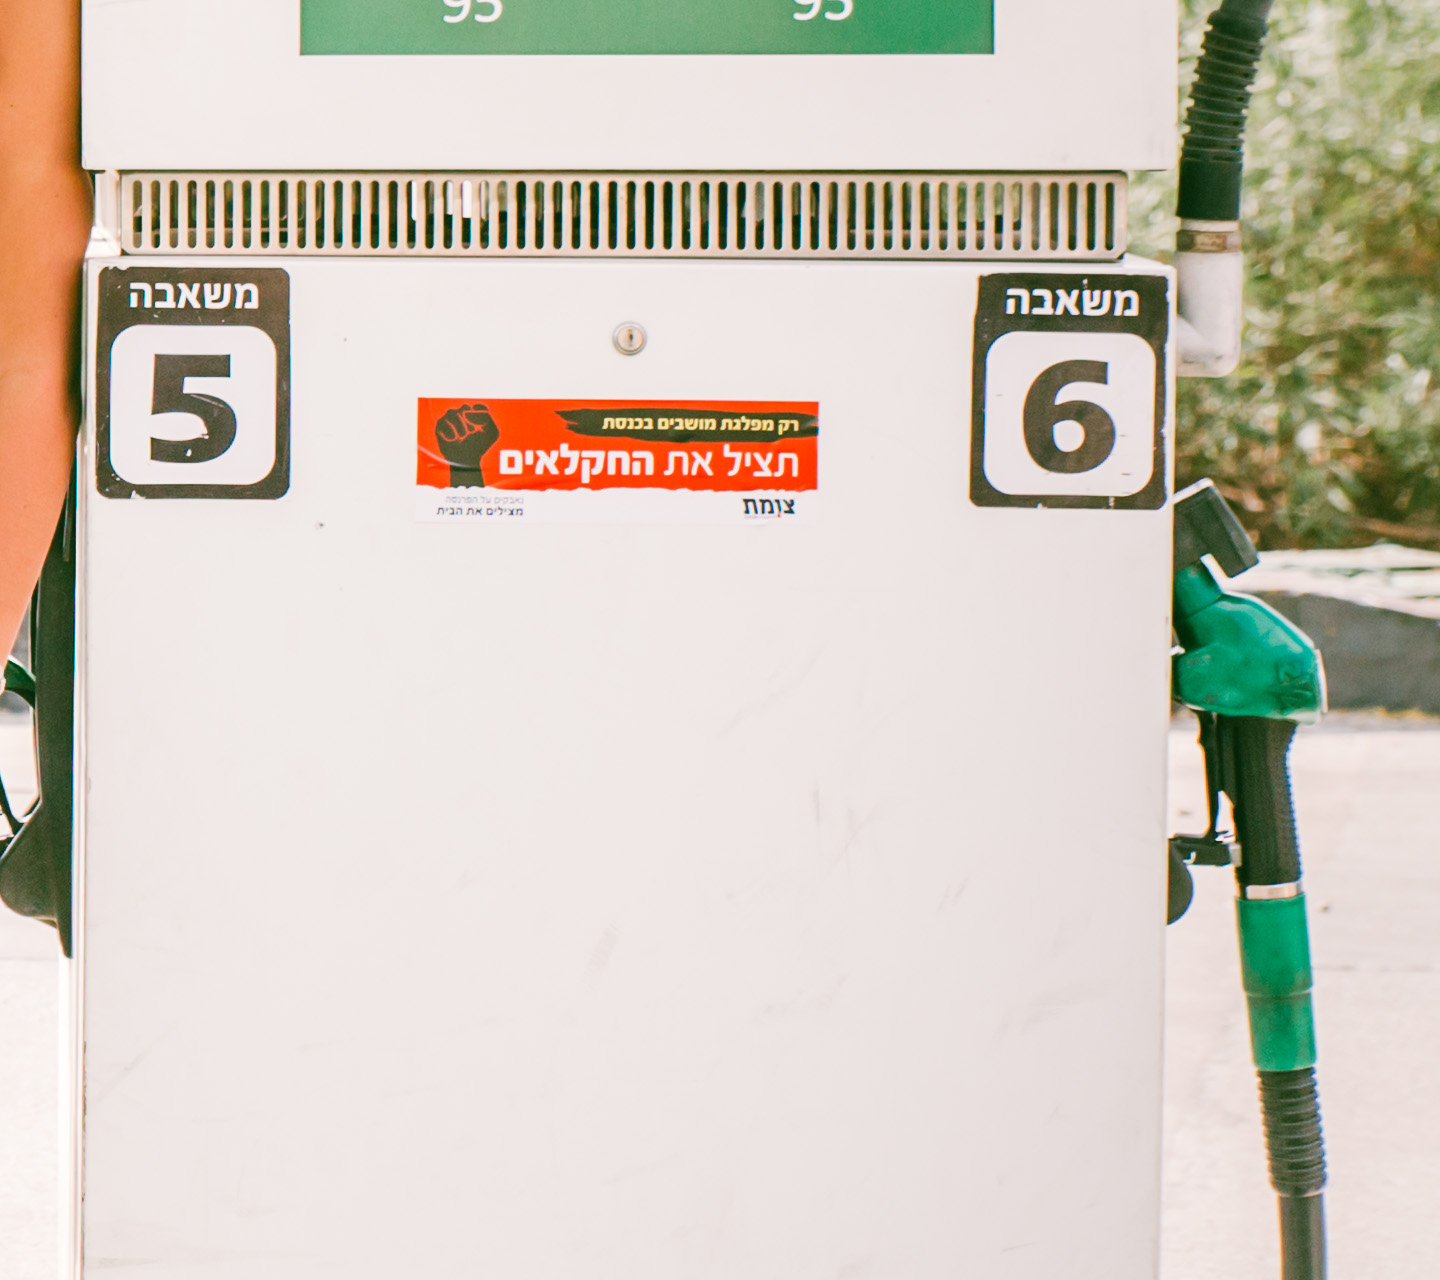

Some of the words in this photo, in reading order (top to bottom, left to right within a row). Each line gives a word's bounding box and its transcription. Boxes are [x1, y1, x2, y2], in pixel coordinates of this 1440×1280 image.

[129, 283, 259, 311] משאבה
[1005, 285, 1139, 316] משאבה
[150, 354, 237, 463] 5
[1022, 360, 1116, 474] 6
[602, 418, 654, 429] בכנסת
[658, 418, 715, 430] מושבים
[720, 416, 774, 431] מפלגת
[778, 420, 799, 435] רק
[499, 443, 654, 483] החקלאים
[664, 451, 713, 476] את
[723, 444, 798, 477] תציל
[487, 507, 523, 515] מצילים
[743, 499, 794, 517] צומת
